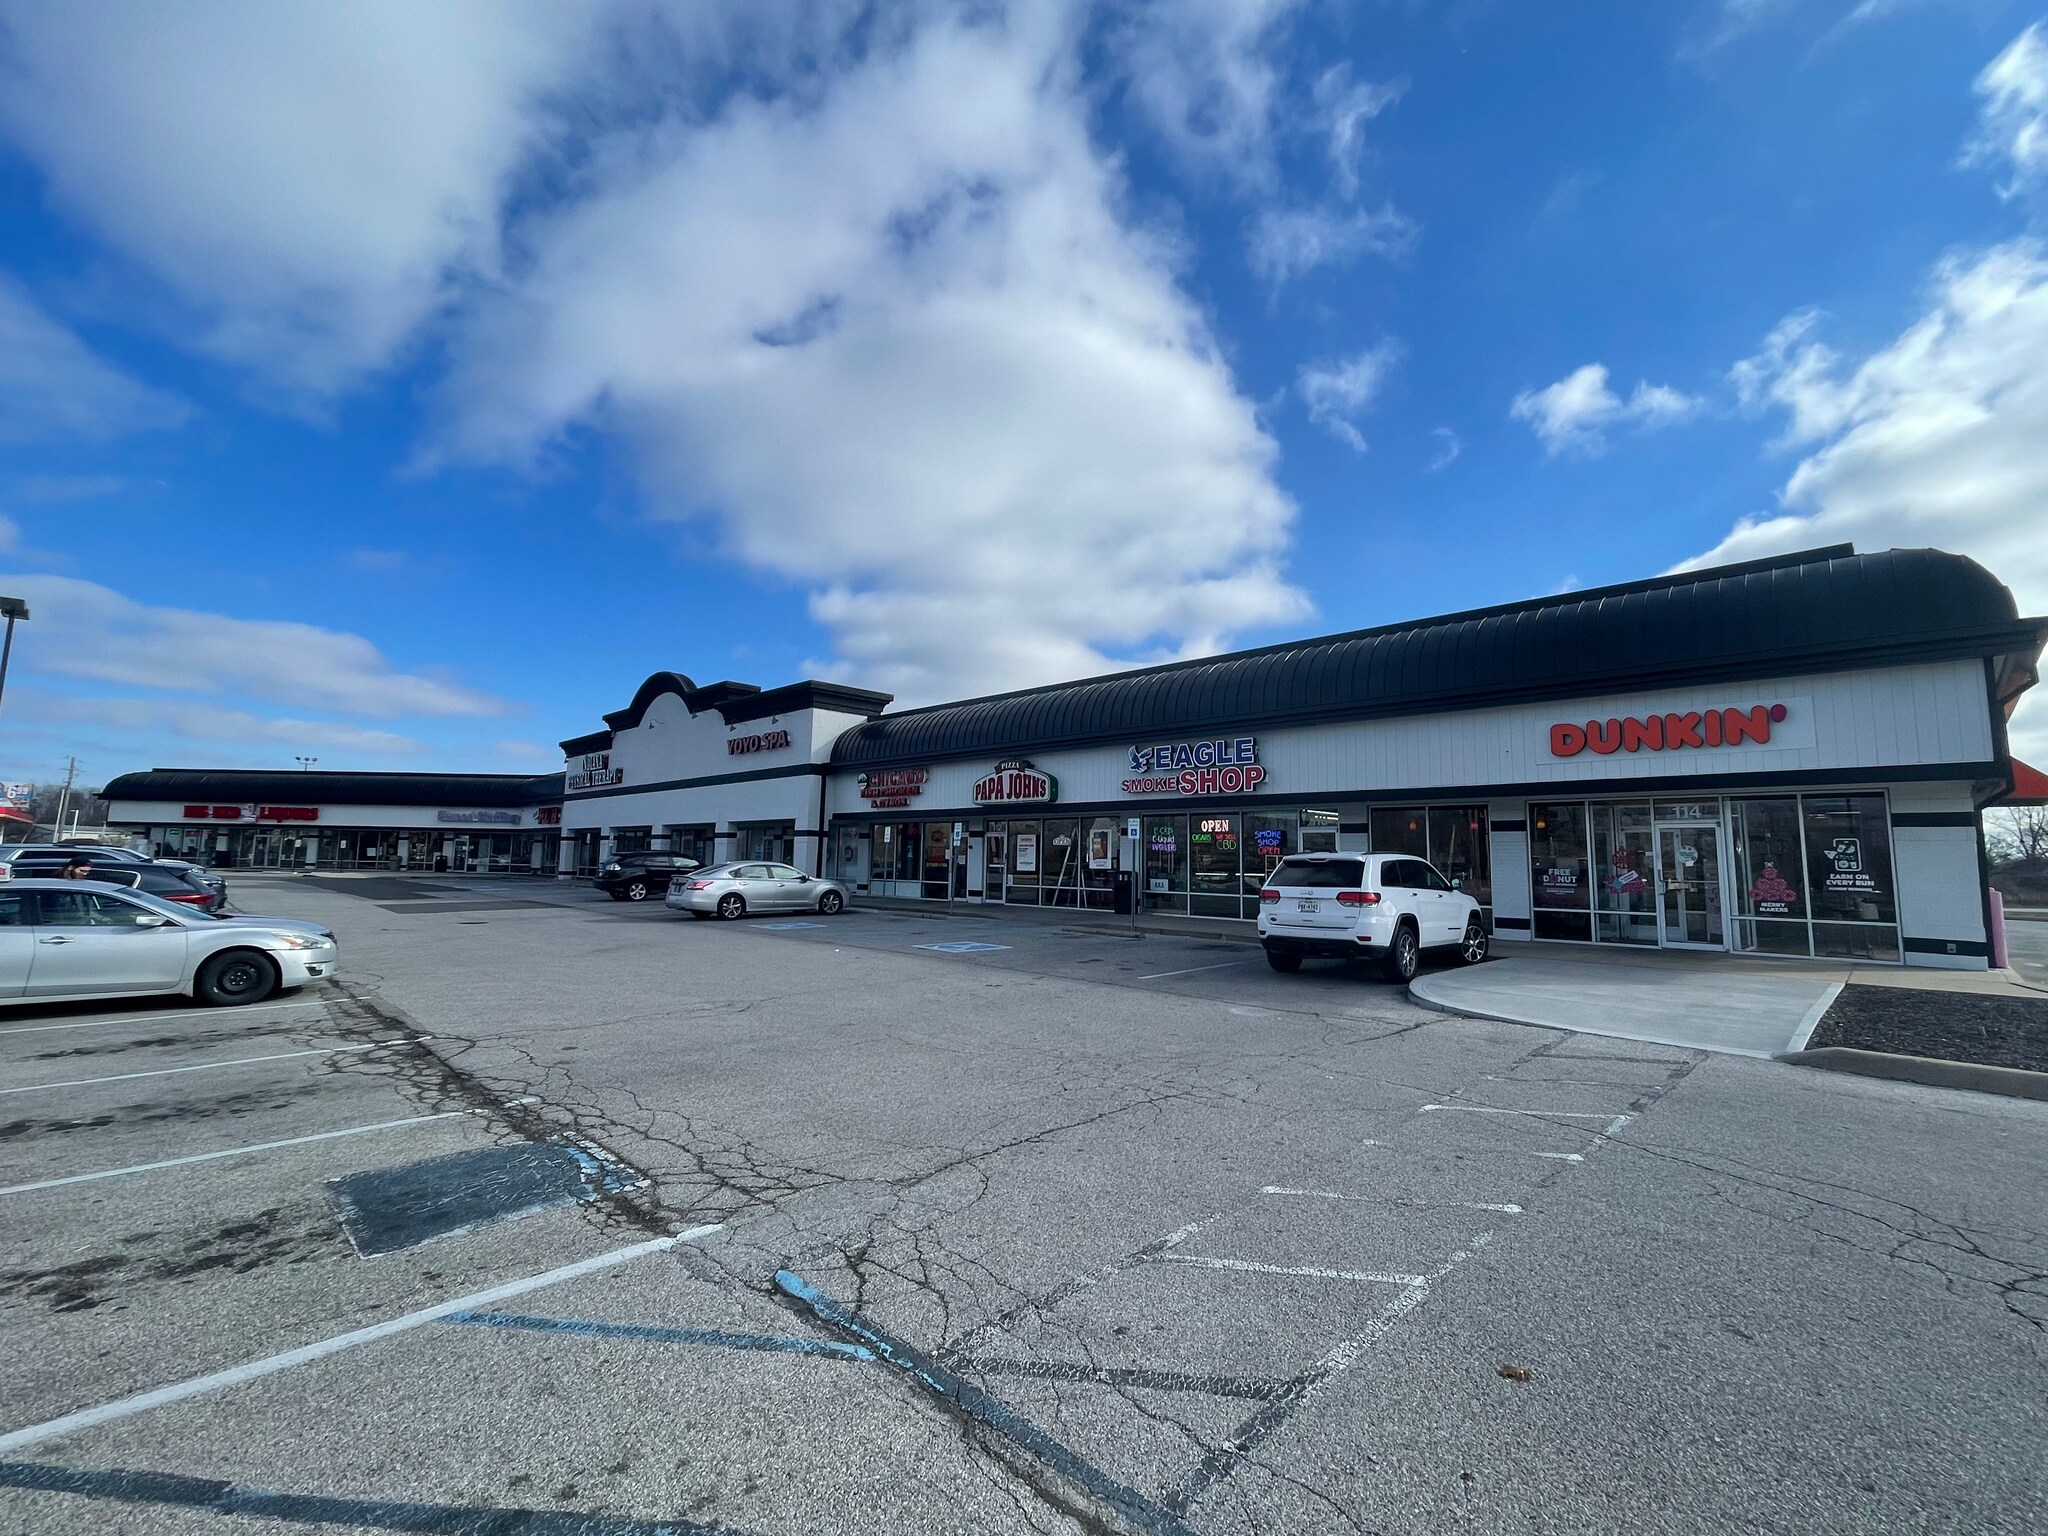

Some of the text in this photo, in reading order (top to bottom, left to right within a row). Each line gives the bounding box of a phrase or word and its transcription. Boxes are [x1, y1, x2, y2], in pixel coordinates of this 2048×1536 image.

[1550, 704, 1788, 758] DUNKIN'
[727, 730, 789, 755] YOYO SPA
[1154, 737, 1255, 770] EAGLE
[1001, 761, 1020, 770] PIZZA
[868, 768, 925, 788] CHICAGO
[1121, 765, 1265, 795] SMOKE SHOP
[975, 774, 1004, 801] PAPA
[1672, 805, 1702, 819] 114
[1201, 820, 1229, 832] OPEN
[1254, 830, 1281, 839] SMOKE
[1216, 839, 1237, 850] CBD
[1257, 838, 1279, 847] SHOP
[1257, 846, 1280, 855] OPEN
[1548, 868, 1571, 876] FREE
